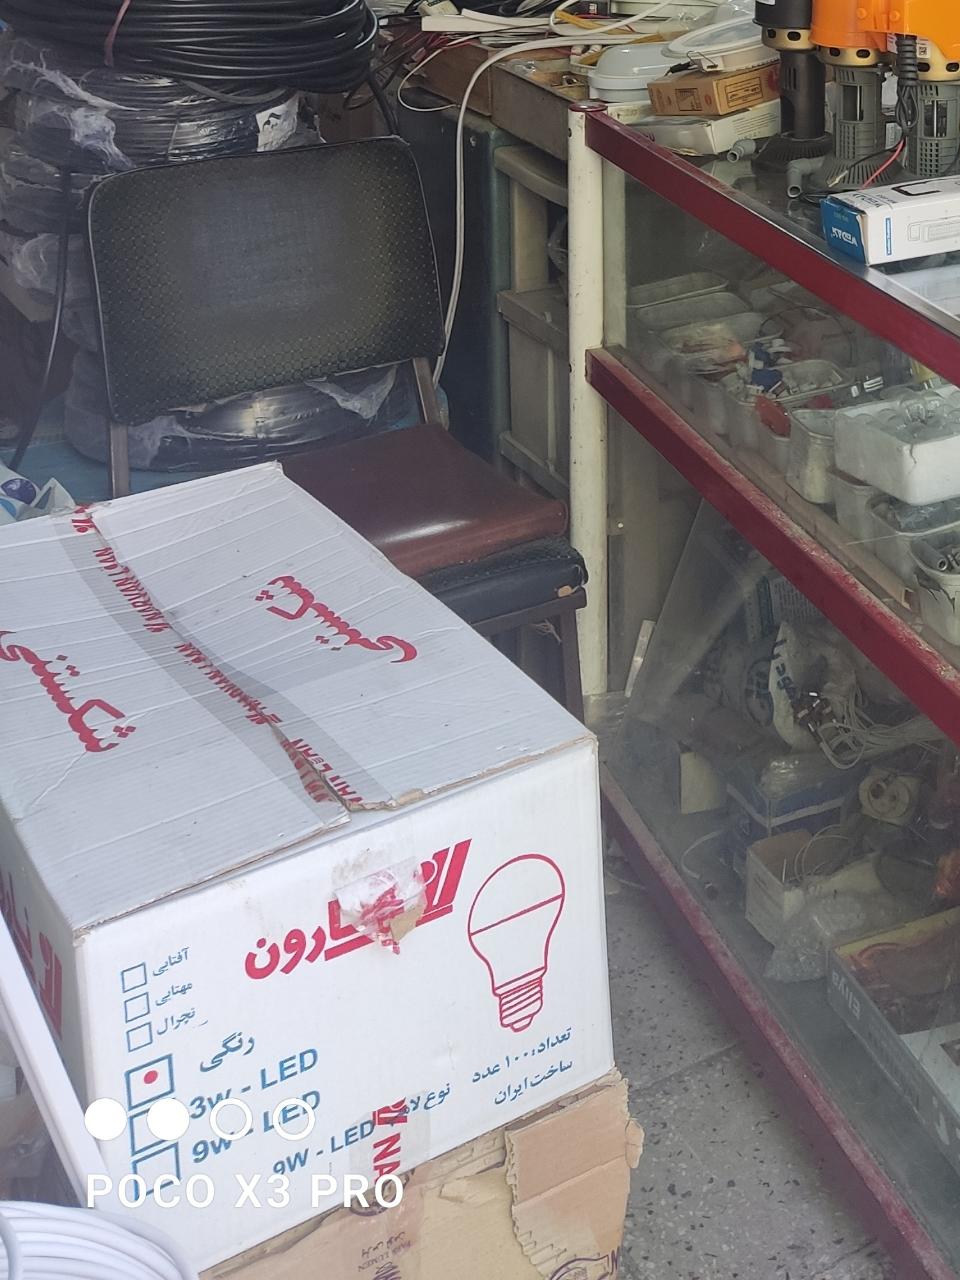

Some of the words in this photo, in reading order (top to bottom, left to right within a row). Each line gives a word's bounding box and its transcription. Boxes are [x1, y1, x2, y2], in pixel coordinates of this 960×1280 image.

[199, 1032, 255, 1073] رنگی
[260, 1048, 319, 1090] LED
[471, 1063, 501, 1084] عدد
[330, 1119, 376, 1154] LED
